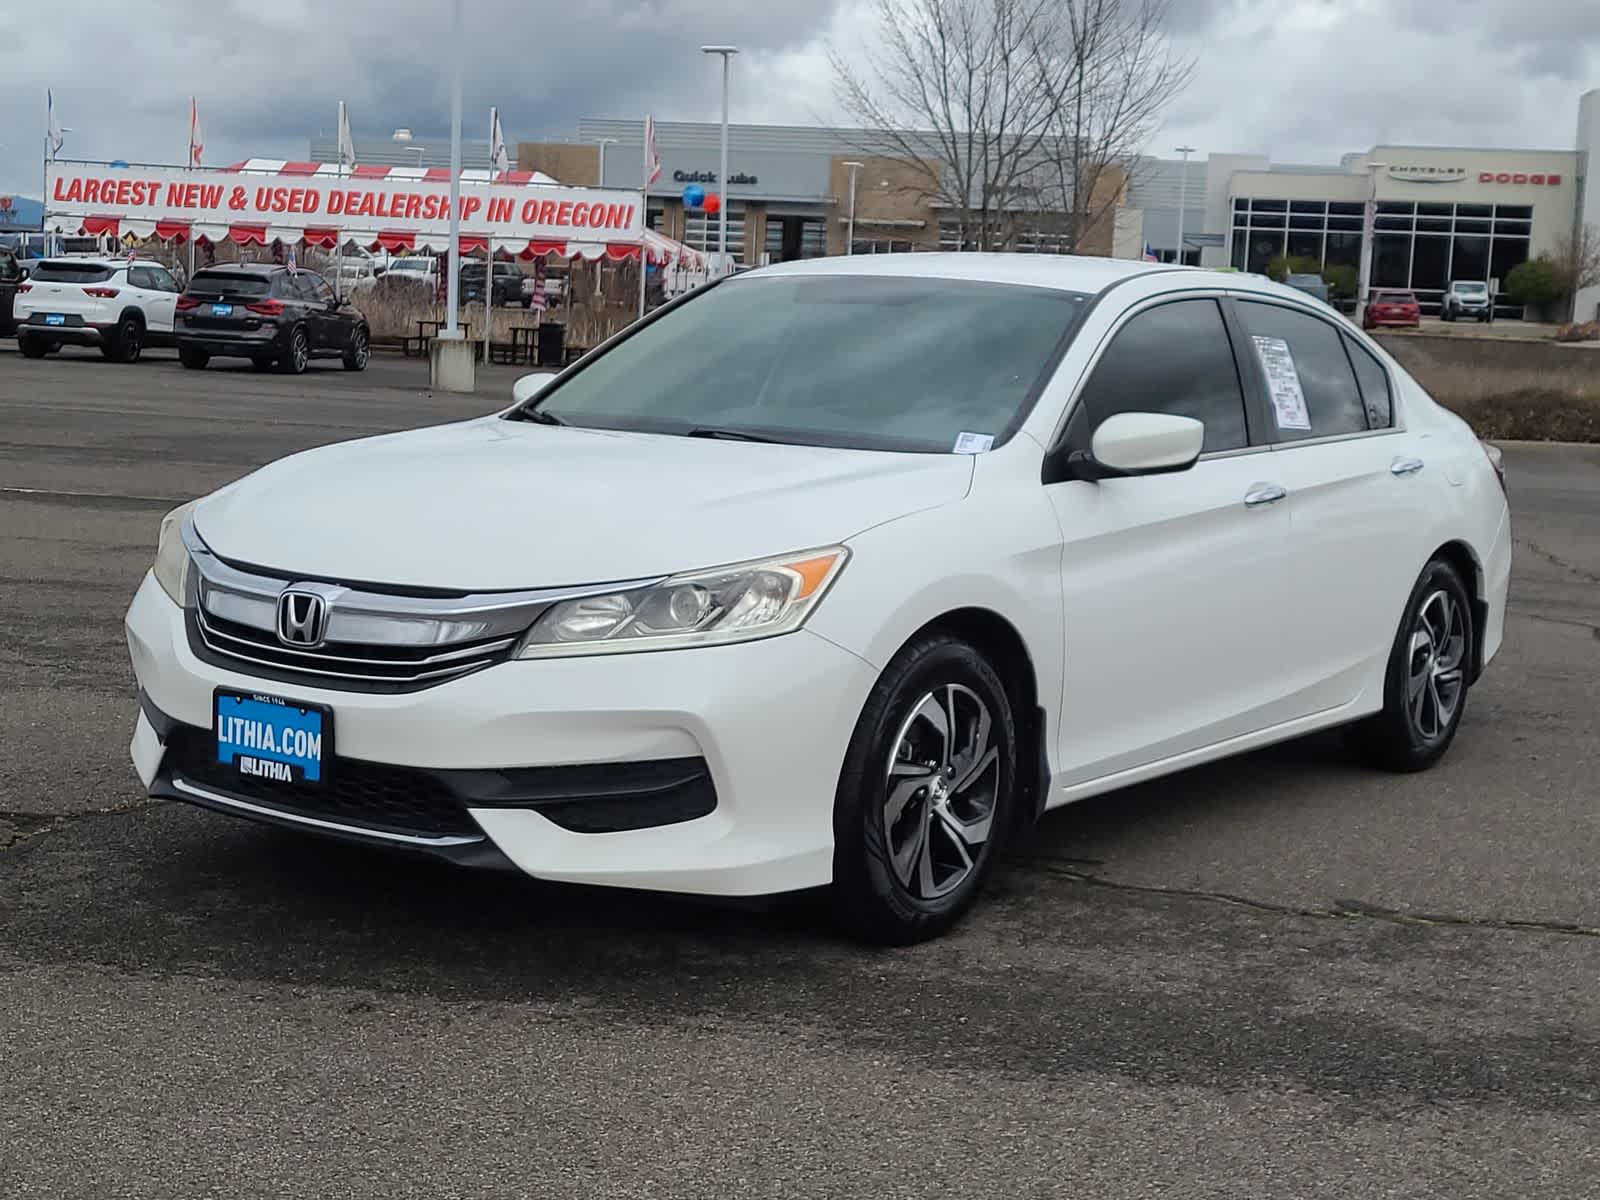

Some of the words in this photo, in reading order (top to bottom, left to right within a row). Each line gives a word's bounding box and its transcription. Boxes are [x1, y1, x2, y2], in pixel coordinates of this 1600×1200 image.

[673, 169, 718, 183] Quick
[1478, 172, 1561, 185] DODGE
[53, 177, 162, 206] LARGEST
[166, 183, 224, 208] NEW
[228, 185, 249, 211] &
[255, 186, 320, 213] USED
[326, 190, 481, 221] DEALERSHIP
[486, 197, 515, 223] IN
[521, 199, 635, 229] OREGON!
[218, 714, 321, 761] LITHIA.COM
[253, 758, 292, 782] LITHIA
